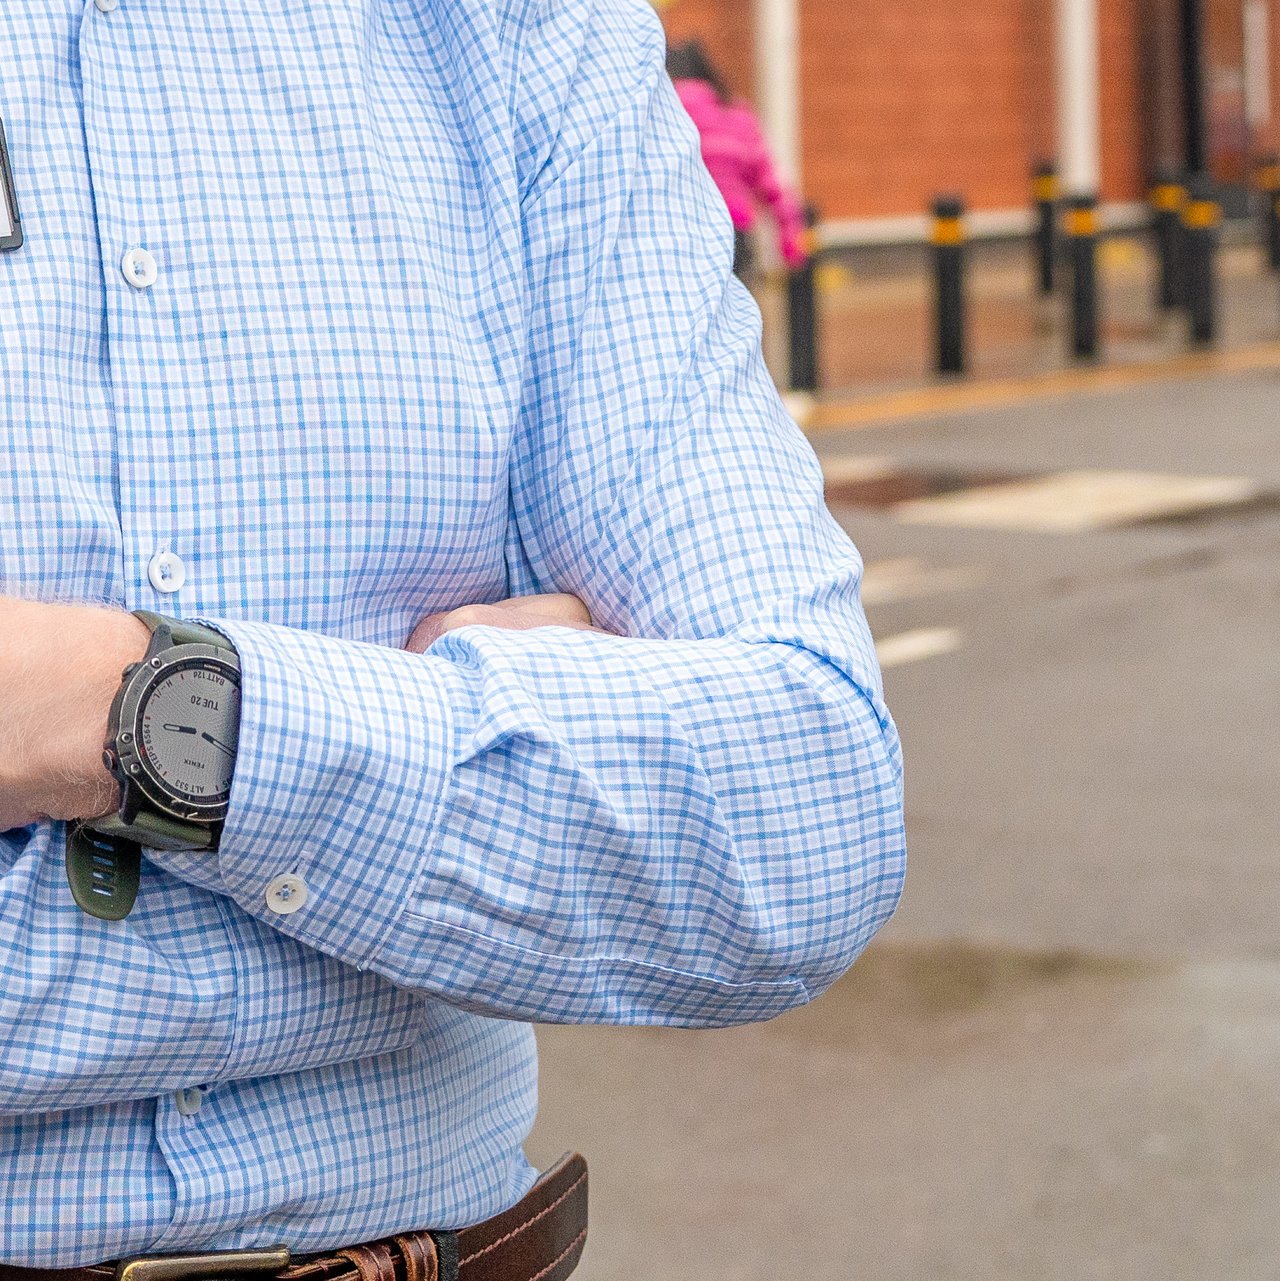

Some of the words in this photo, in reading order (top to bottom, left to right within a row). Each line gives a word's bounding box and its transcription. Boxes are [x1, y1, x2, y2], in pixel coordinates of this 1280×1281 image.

[206, 674, 225, 686] BATT
[190, 695, 202, 705] 20
[203, 698, 219, 711] TUE
[143, 723, 152, 745] 6564
[146, 746, 163, 771] STEPS
[174, 779, 189, 791] 533
[190, 785, 205, 794] ALT
